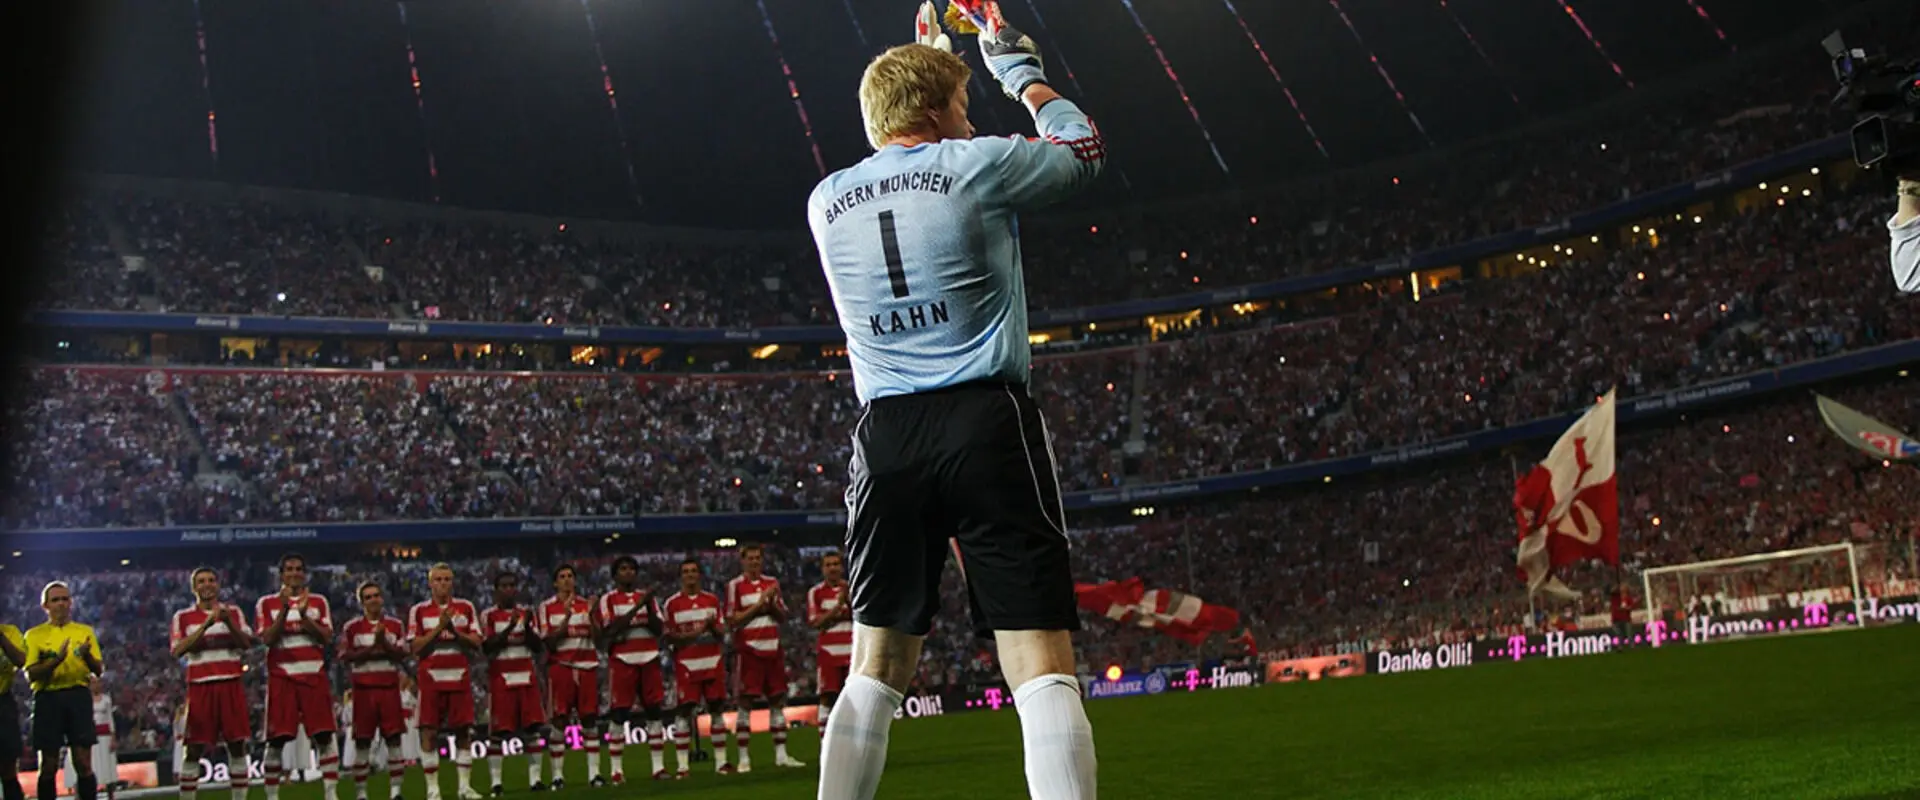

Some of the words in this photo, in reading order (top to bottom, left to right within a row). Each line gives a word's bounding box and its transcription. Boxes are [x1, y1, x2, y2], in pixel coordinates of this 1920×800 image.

[824, 183, 875, 225] BAYERN
[878, 209, 910, 299] 1
[869, 301, 949, 336] KAHN
[180, 531, 218, 541] Allianz
[235, 528, 269, 540] Global
[270, 527, 318, 538] Investors
[1378, 648, 1433, 674] Danke
[1436, 642, 1473, 669] Olli!
[1545, 630, 1612, 658] Home
[1091, 680, 1144, 698] Allianz
[1212, 666, 1252, 690] Hom
[904, 695, 943, 718] Olli!
